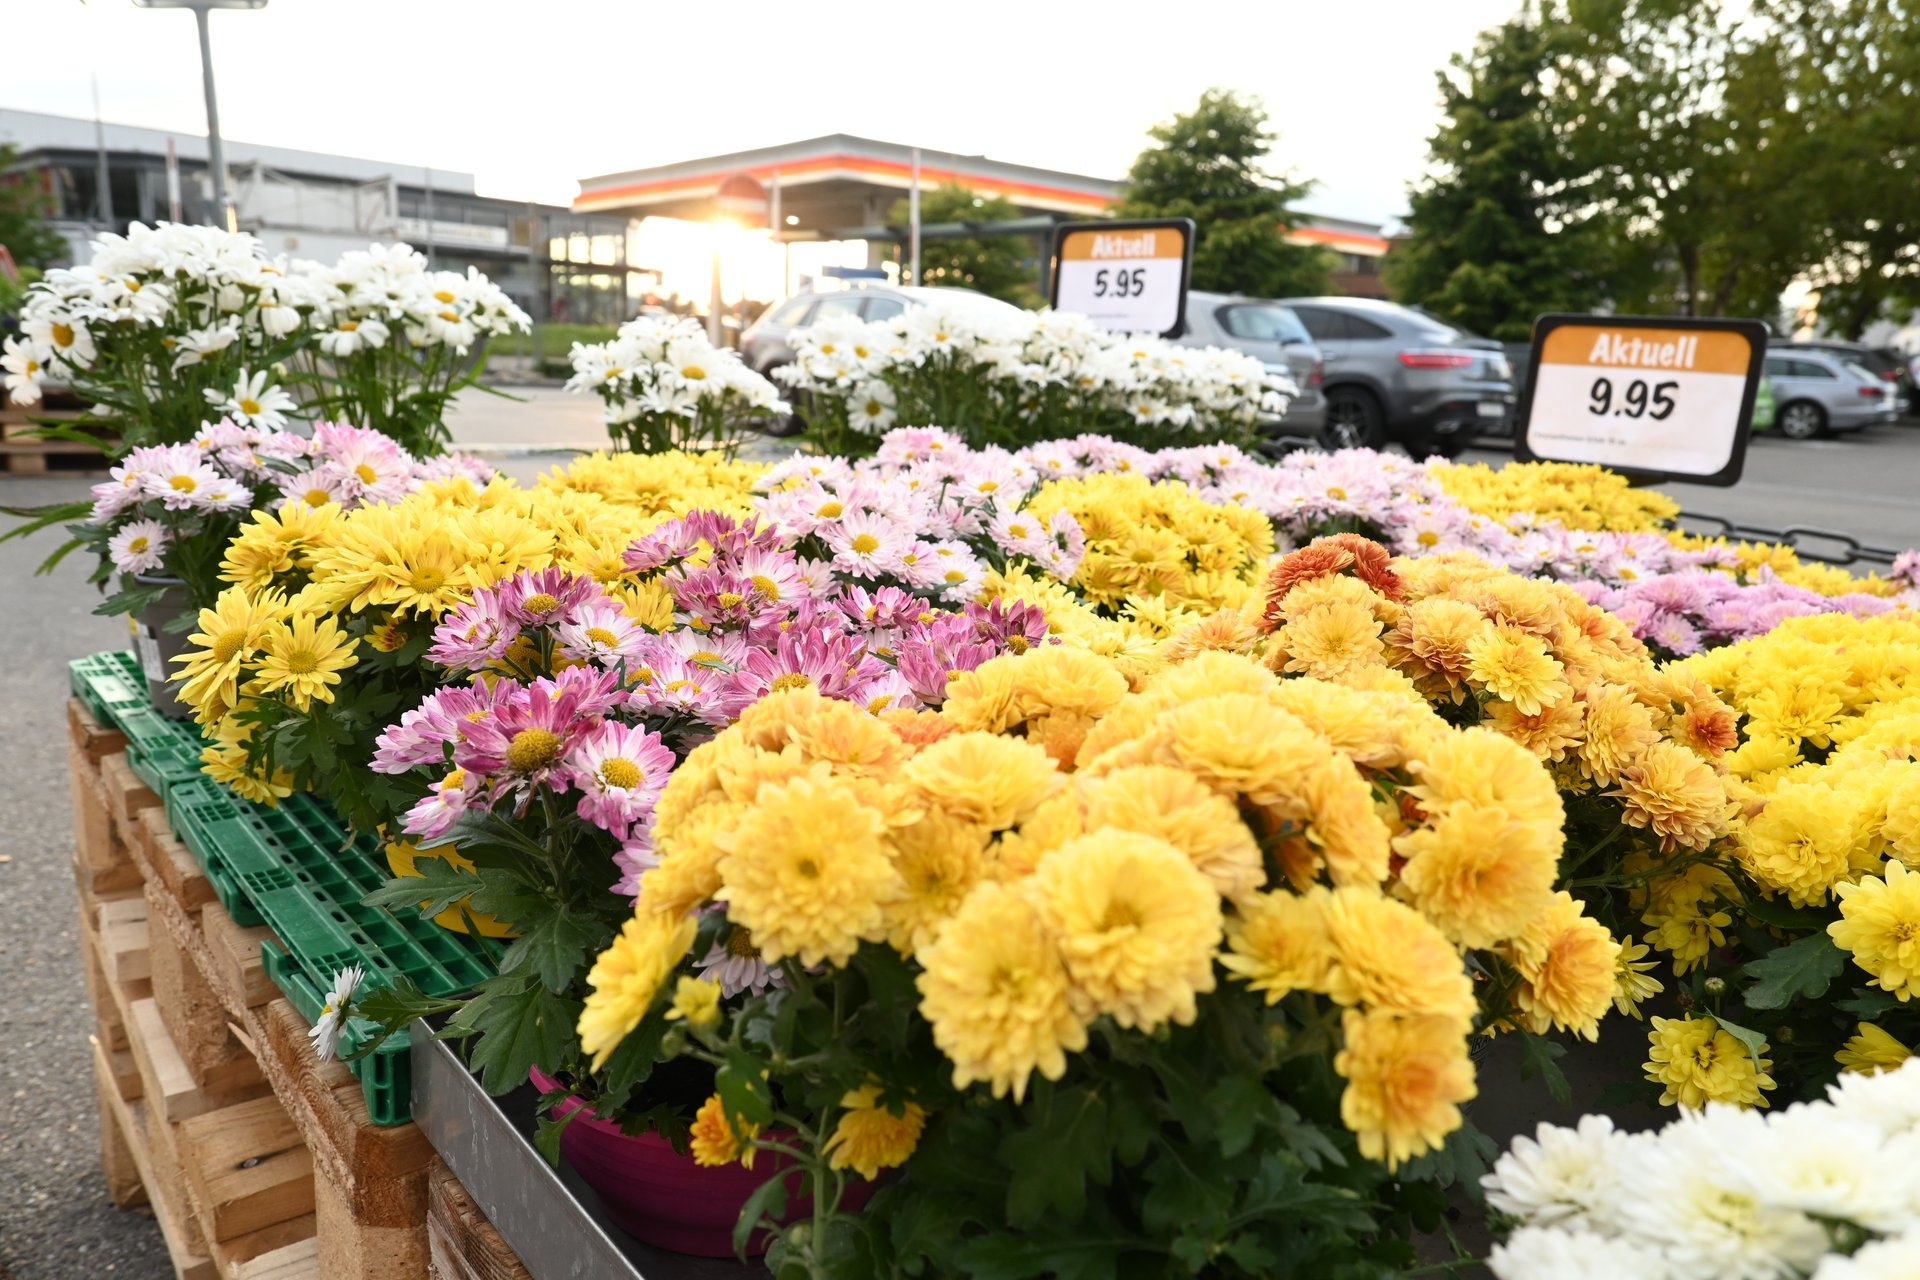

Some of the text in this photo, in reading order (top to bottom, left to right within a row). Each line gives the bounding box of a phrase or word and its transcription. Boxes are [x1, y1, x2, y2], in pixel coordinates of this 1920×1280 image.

[1091, 232, 1156, 258] Aktuell
[1094, 268, 1146, 297] 5.95
[1588, 332, 1698, 369] Aktuell
[1588, 377, 1679, 420] 9.95
